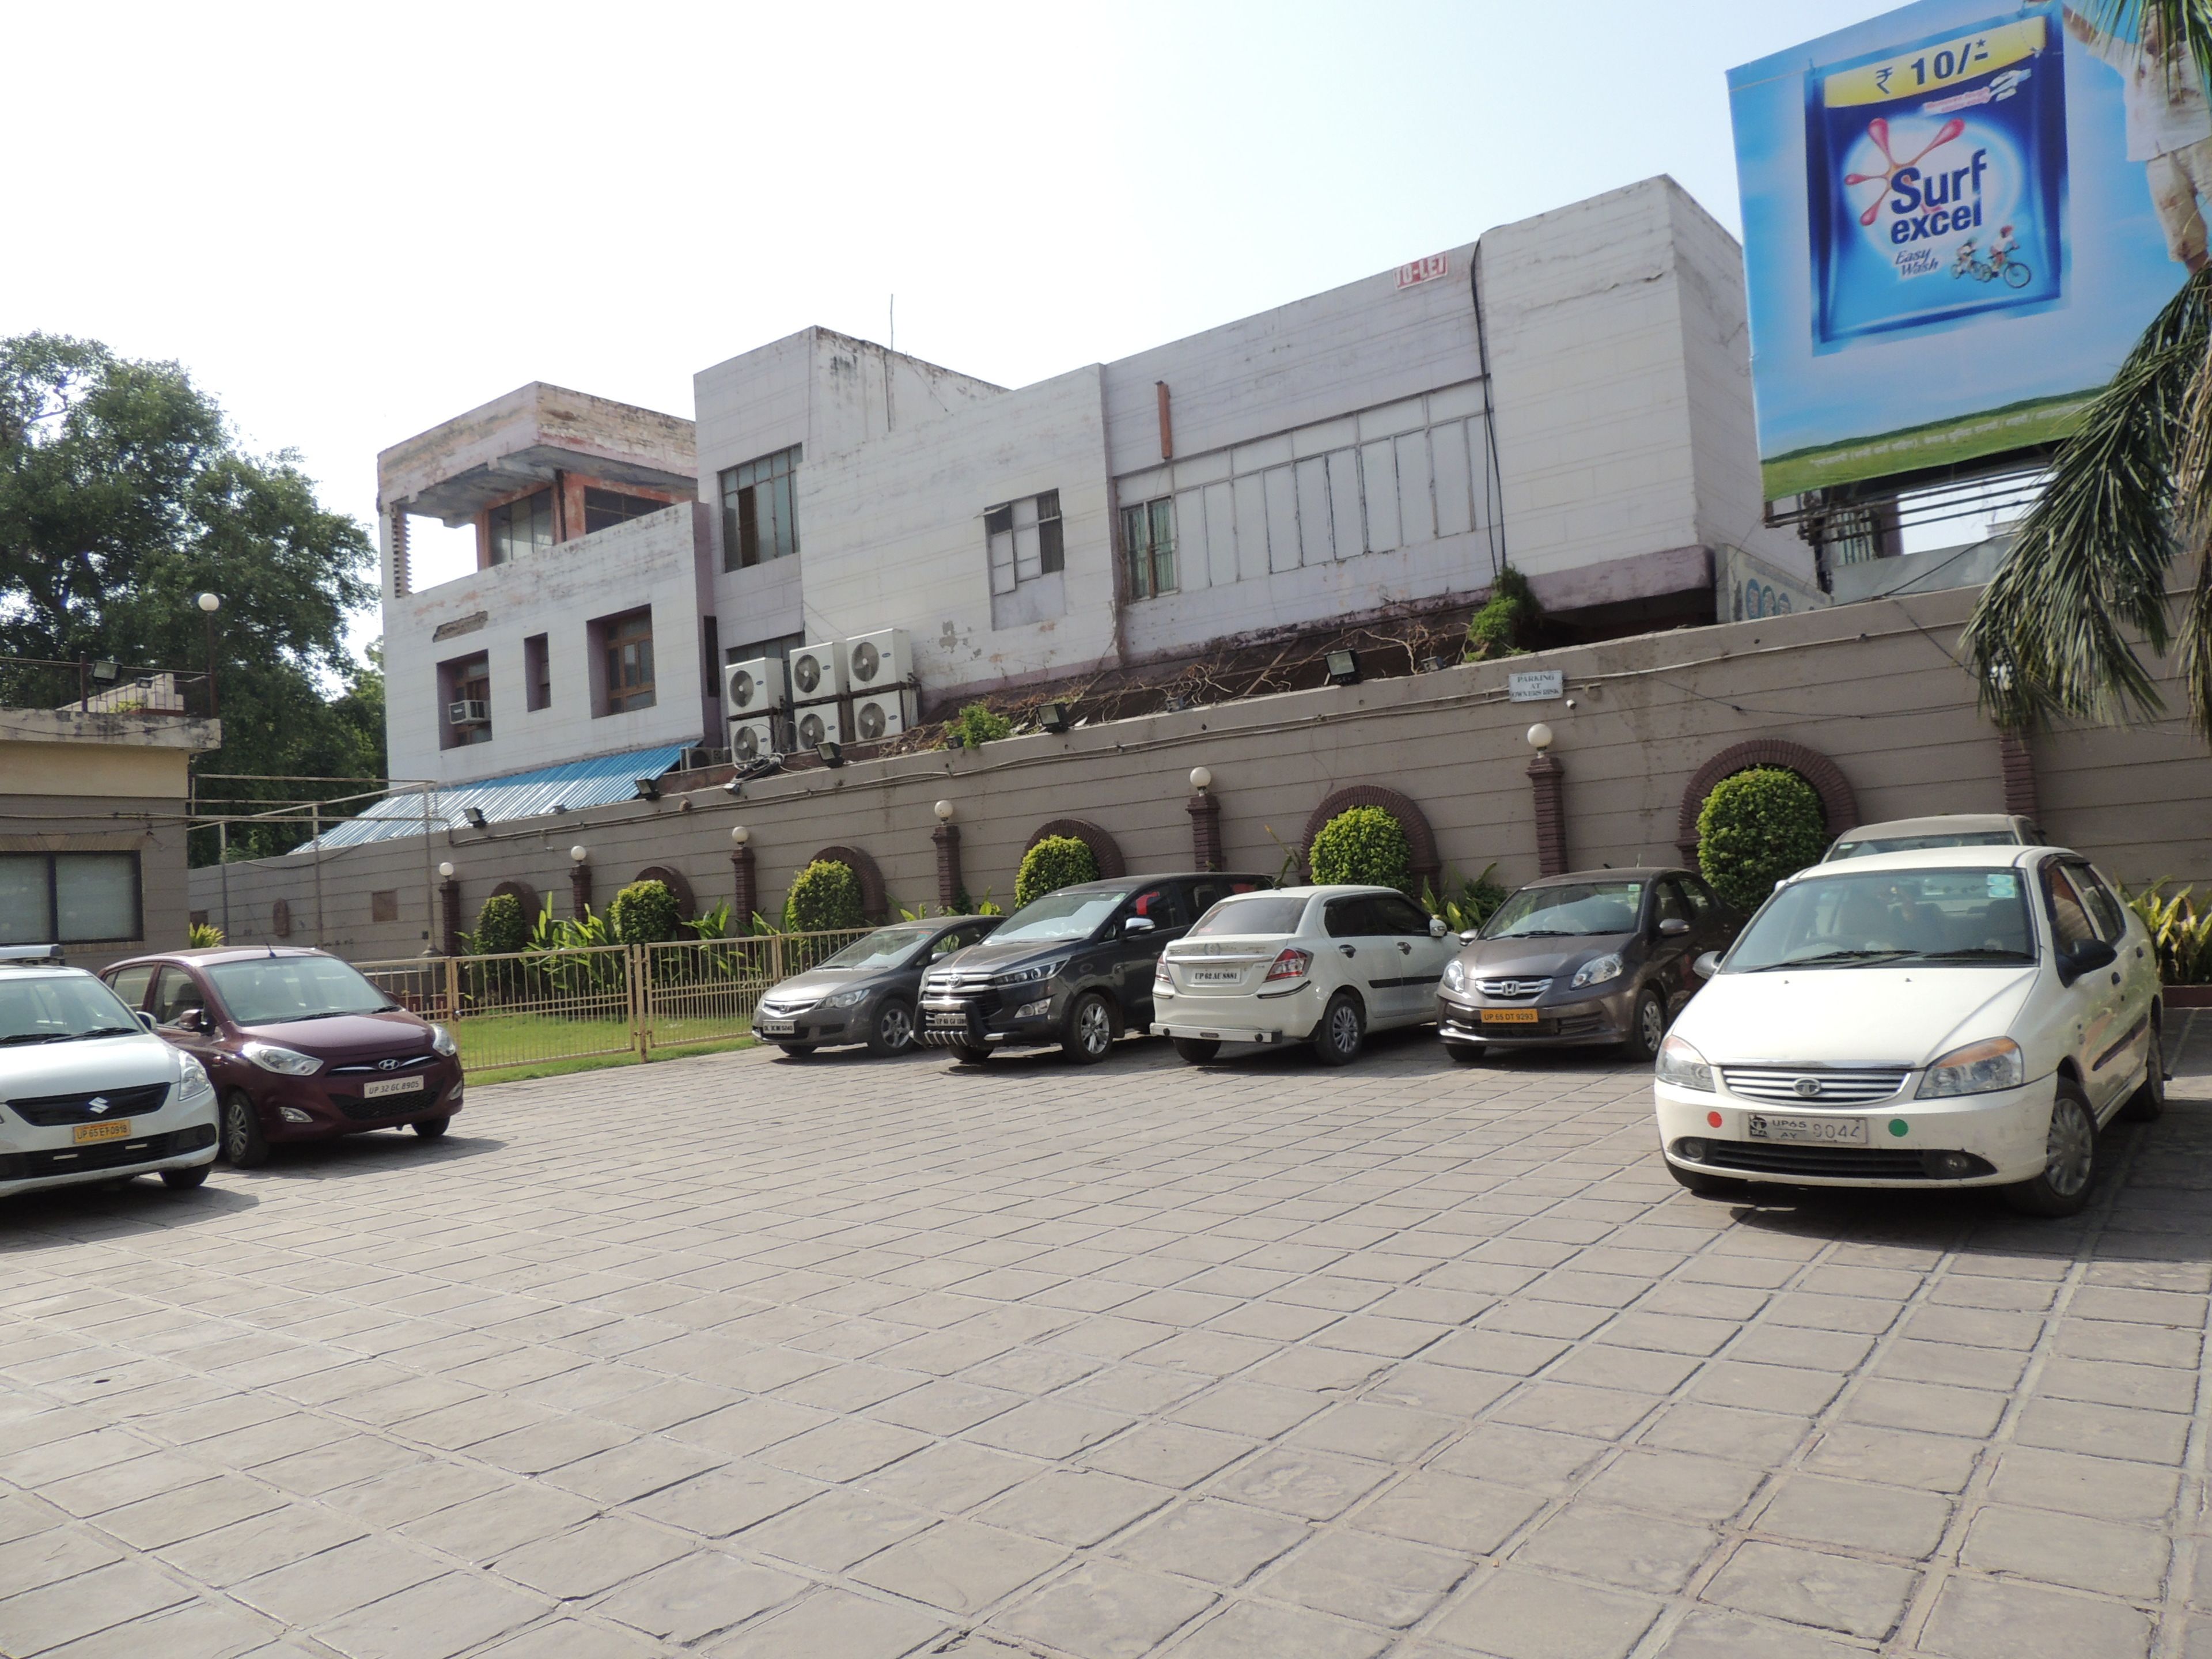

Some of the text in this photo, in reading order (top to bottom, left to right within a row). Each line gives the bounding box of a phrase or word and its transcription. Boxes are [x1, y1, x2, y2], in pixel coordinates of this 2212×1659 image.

[1890, 147, 1987, 215] Surf
[1891, 197, 1982, 245] excel
[1895, 248, 1931, 265] Easy
[1902, 257, 1939, 276] Wash
[1517, 675, 1555, 683] PARKING
[369, 1086, 379, 1094] UP
[380, 1085, 389, 1093] 32
[77, 1130, 87, 1139] UP
